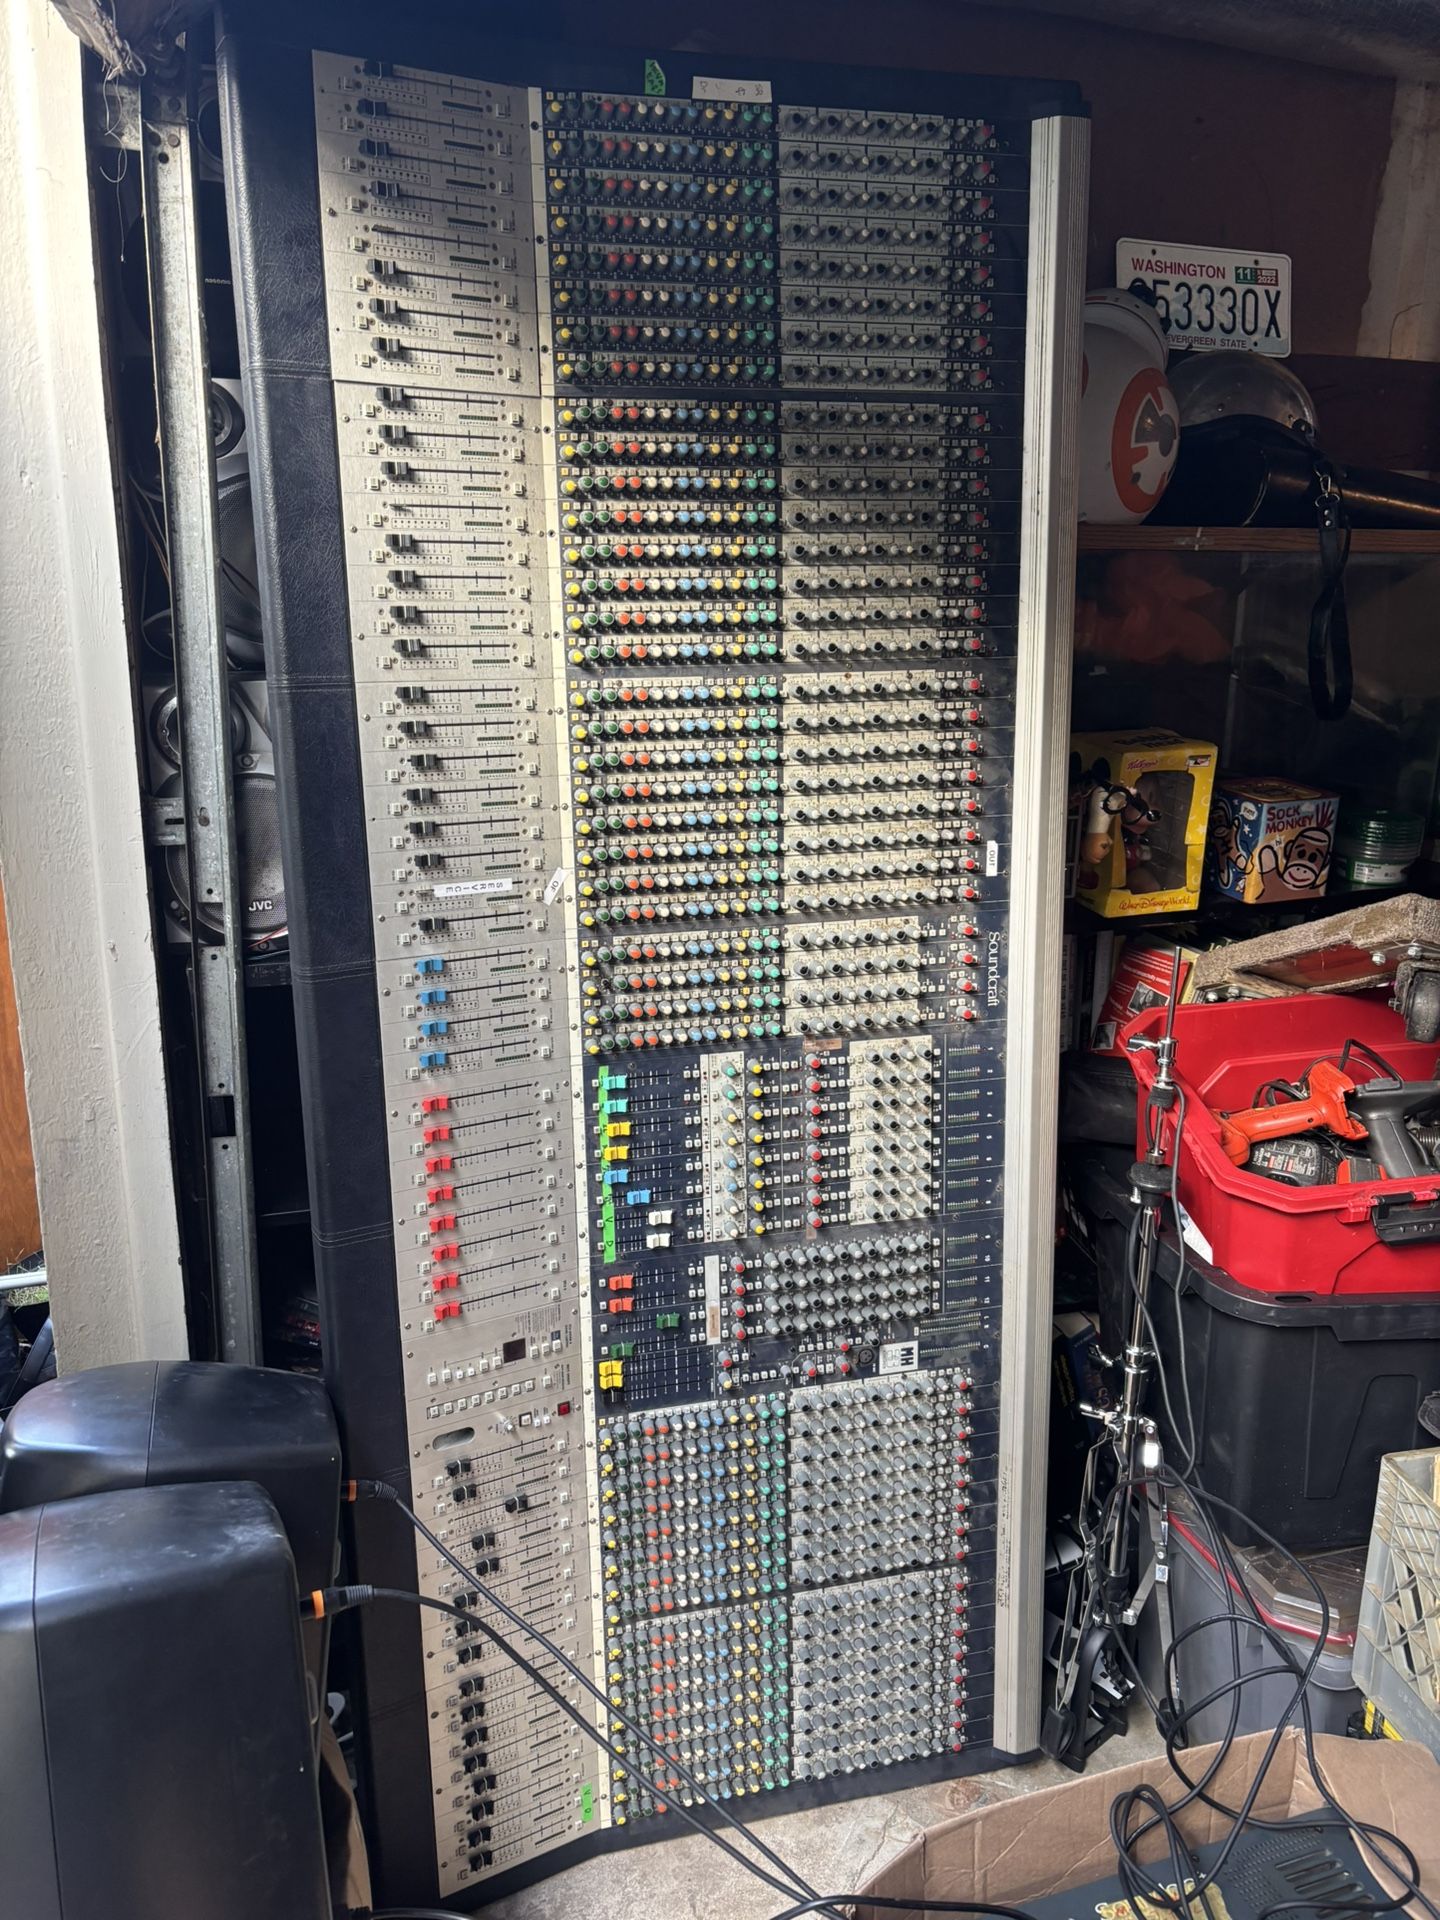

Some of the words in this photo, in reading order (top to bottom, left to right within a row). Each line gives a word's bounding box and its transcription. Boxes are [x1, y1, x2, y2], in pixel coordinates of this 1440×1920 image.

[1131, 257, 1226, 279] WASHINGTON
[1237, 268, 1251, 280] 11
[1128, 278, 1281, 338] 53330X
[1220, 338, 1247, 348] STATE
[1267, 806, 1300, 821] SOCK
[1266, 815, 1314, 834] MONKEY
[989, 850, 997, 867] OUT
[446, 882, 503, 893] SERVICE
[249, 900, 273, 911] JVC
[988, 931, 1000, 1007] Soundcraft
[901, 1346, 914, 1367] MH
